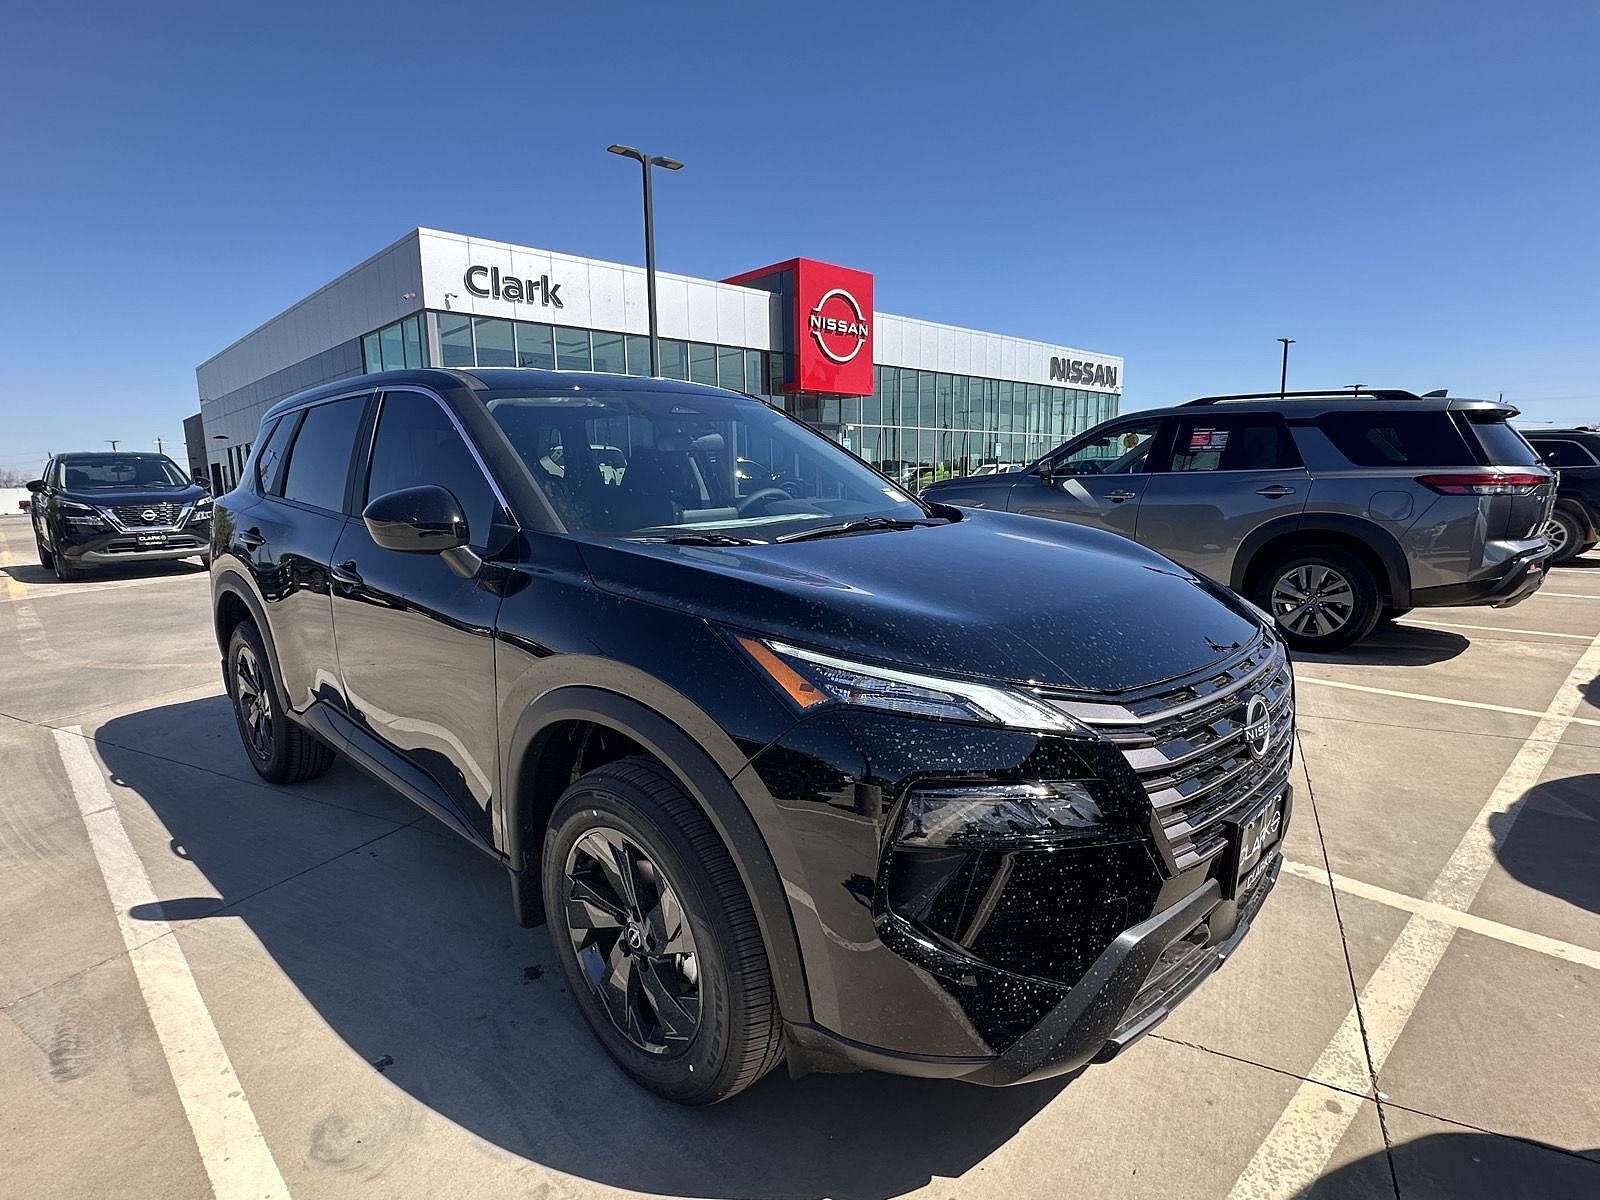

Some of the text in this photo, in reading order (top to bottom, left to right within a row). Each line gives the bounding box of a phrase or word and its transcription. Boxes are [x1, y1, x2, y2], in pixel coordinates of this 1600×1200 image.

[464, 265, 563, 309] Clark
[810, 315, 868, 336] NISSAN
[1050, 357, 1117, 388] NISSAN
[1246, 722, 1269, 741] NISS
